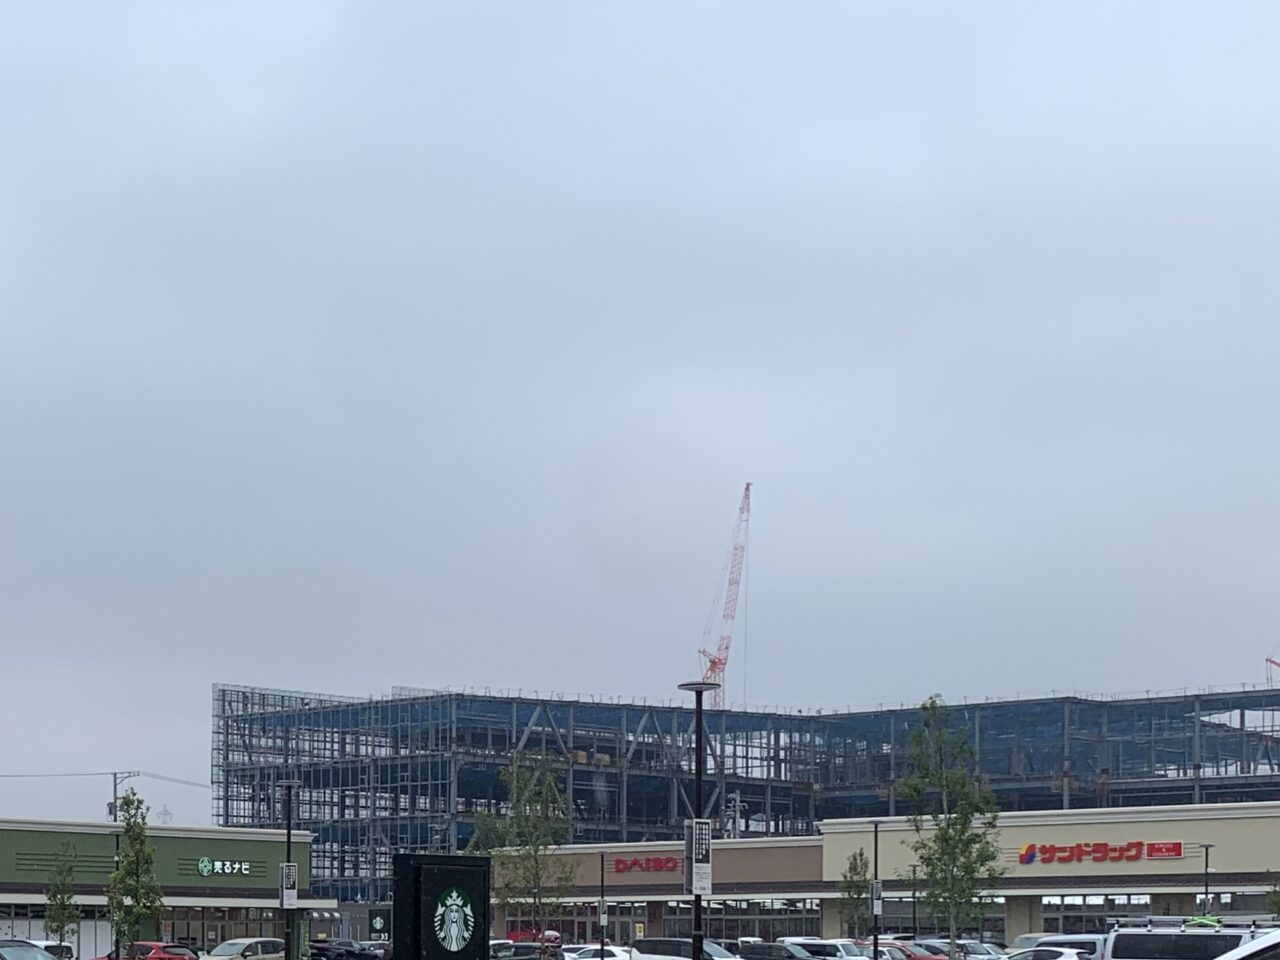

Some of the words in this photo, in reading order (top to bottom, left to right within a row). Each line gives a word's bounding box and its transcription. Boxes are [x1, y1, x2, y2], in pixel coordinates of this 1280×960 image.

[1039, 841, 1143, 863] サンドラッグ
[213, 861, 250, 874] 売るナビ
[614, 857, 678, 873] DAISO
